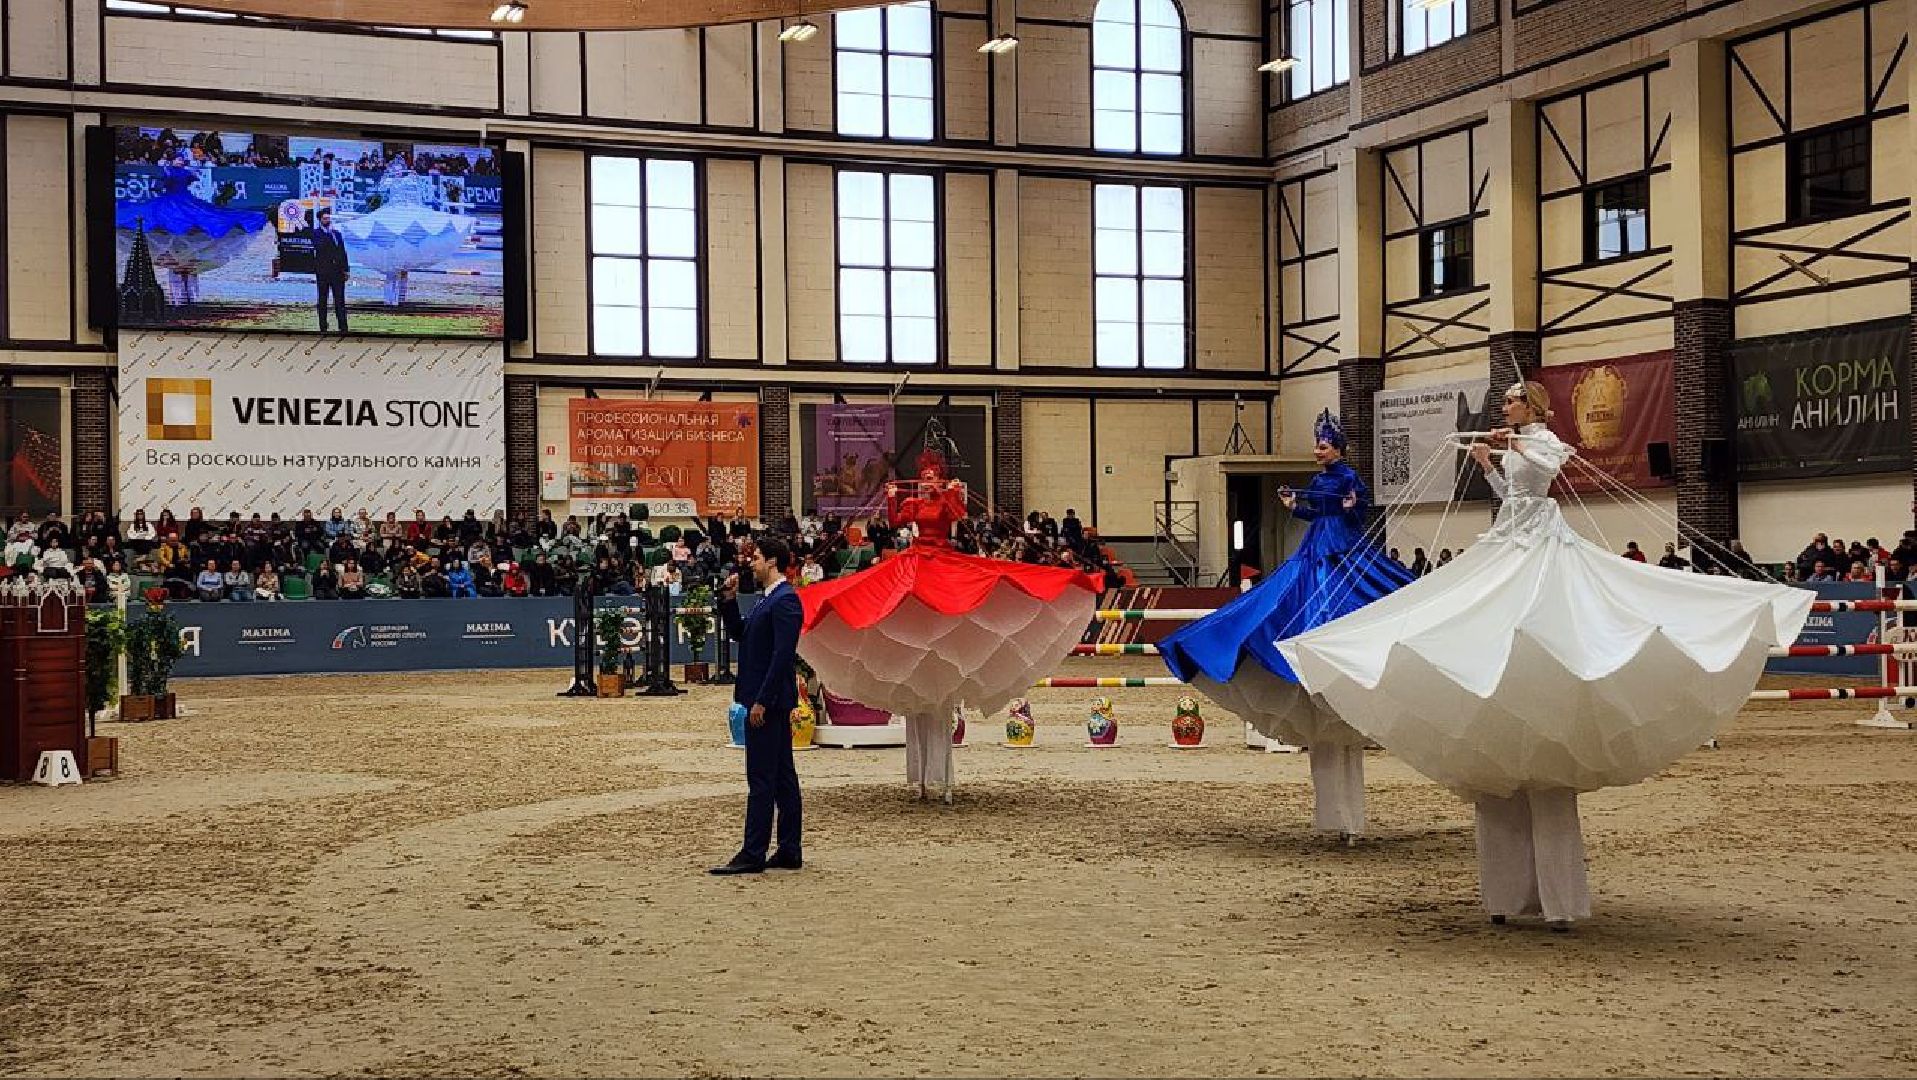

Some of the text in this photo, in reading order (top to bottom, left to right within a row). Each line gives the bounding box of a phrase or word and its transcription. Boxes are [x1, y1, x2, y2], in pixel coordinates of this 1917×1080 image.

[1796, 355, 1897, 397] КОРМА
[232, 396, 481, 429] VENEZIA STONE
[577, 411, 719, 426] ПРОФЕССИОНАЛЬНАЯ
[1791, 389, 1899, 430] АНИЛИН
[1737, 412, 1780, 430] АНИЛИН
[577, 428, 745, 443] АРОМАТИЗАЦИЯ БИЗНЕСА
[146, 449, 481, 471] Вся роскошь натурального камня
[577, 445, 662, 459] «ПОД КЛЮЧ»
[241, 628, 291, 638] MAXIMA
[466, 623, 512, 633] MAXIMA
[60, 756, 71, 779] 8
